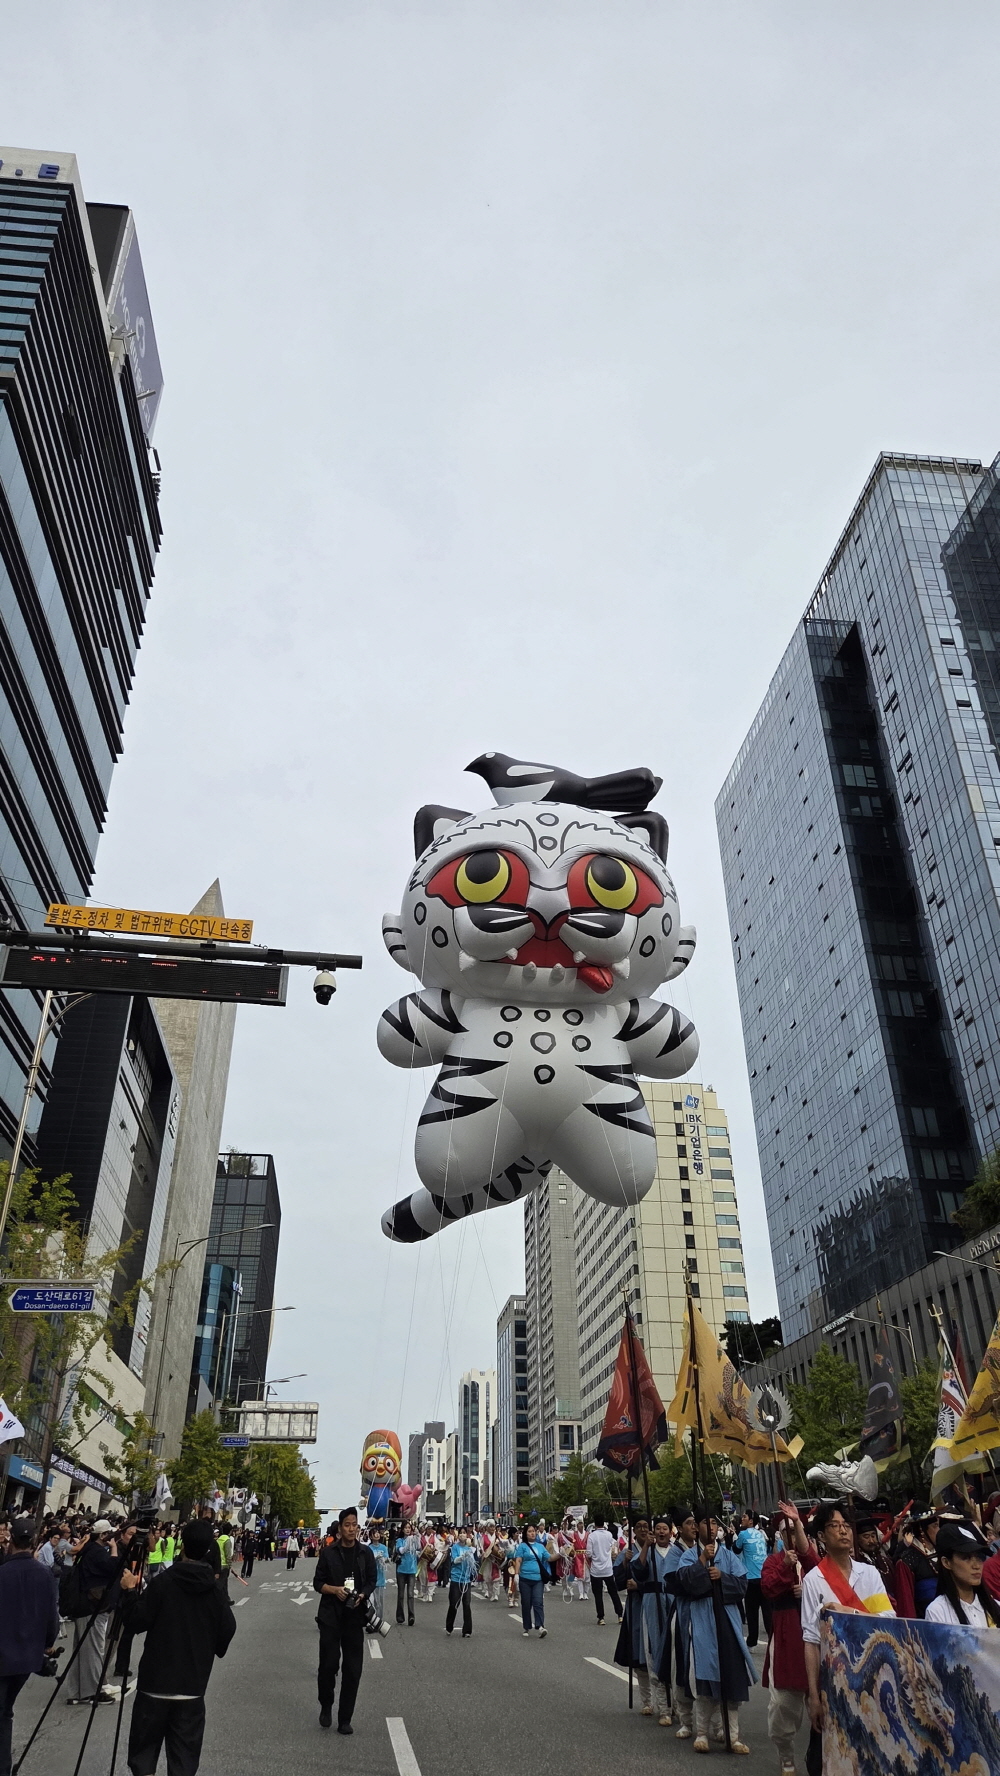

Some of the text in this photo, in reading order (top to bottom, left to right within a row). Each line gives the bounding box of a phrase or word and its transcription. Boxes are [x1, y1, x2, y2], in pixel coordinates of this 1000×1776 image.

[114, 913, 125, 929] 및
[131, 915, 173, 934] 법규위반
[179, 918, 216, 937] CCTV
[221, 922, 251, 940] 단속중
[685, 1113, 702, 1123] IBK
[689, 1125, 704, 1175] 기업은행
[33, 1291, 93, 1303] 도산대로61길
[24, 1302, 91, 1311] Dosan-daero 61-gil
